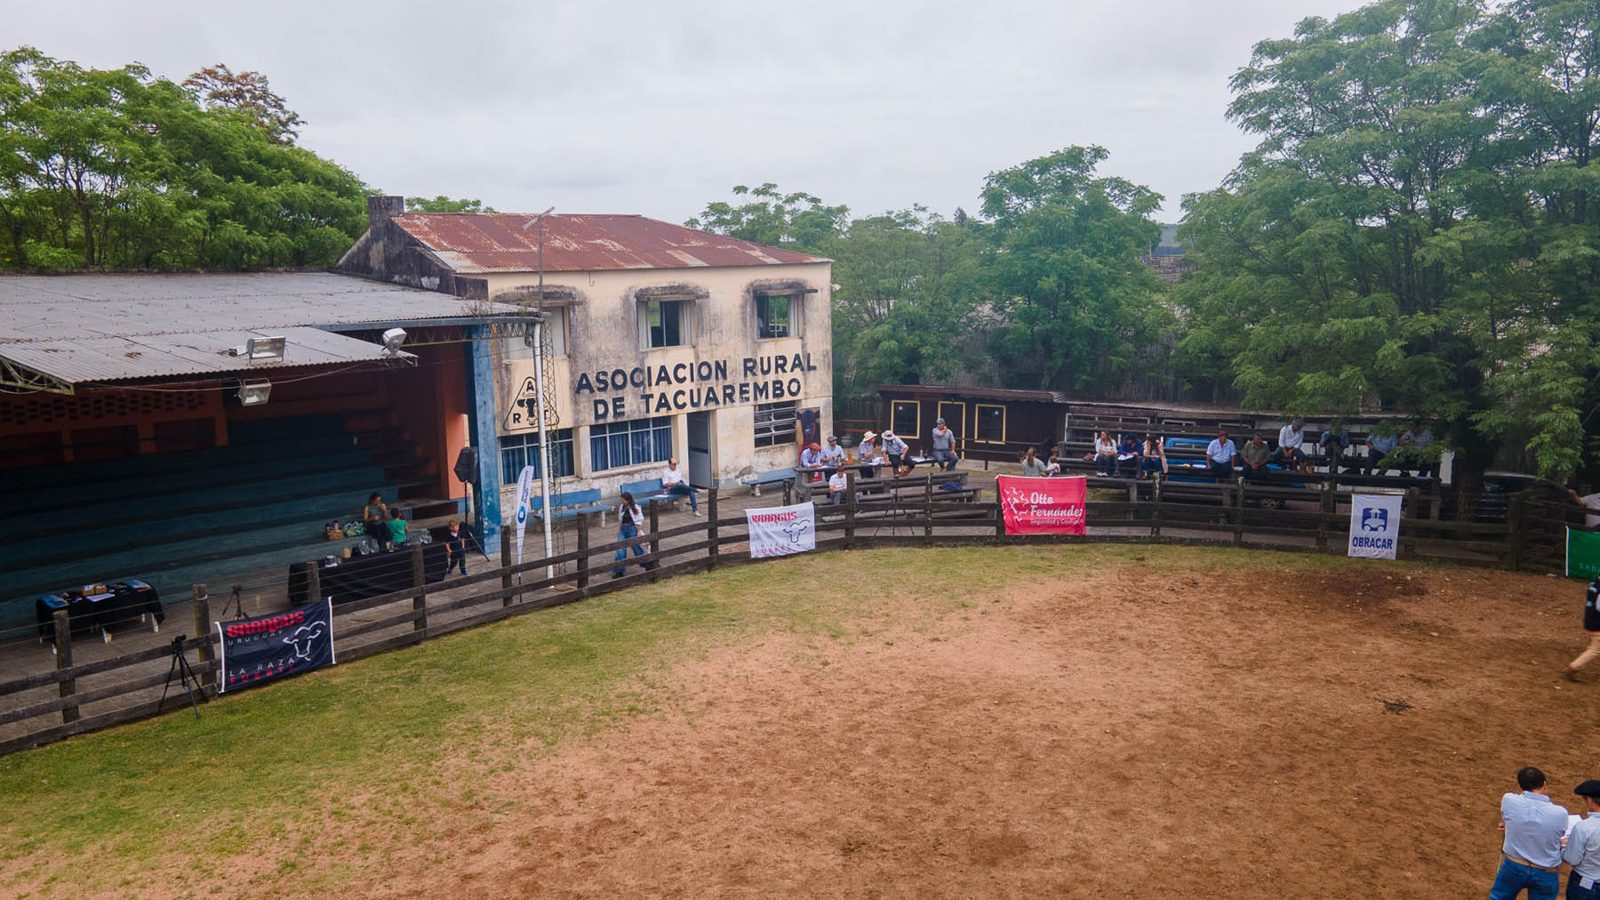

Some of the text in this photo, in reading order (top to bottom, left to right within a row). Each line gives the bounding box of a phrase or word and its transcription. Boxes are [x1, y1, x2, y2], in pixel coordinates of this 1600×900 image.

[575, 351, 818, 395] ASOCIACION RURAL
[526, 381, 535, 392] A
[593, 377, 802, 420] DE TACUAREMBO
[512, 412, 522, 424] R
[1030, 492, 1055, 505] Otto
[1352, 536, 1393, 550] OBRACAR
[228, 630, 283, 646] URUGUAY
[229, 657, 295, 677] LA RAZA
